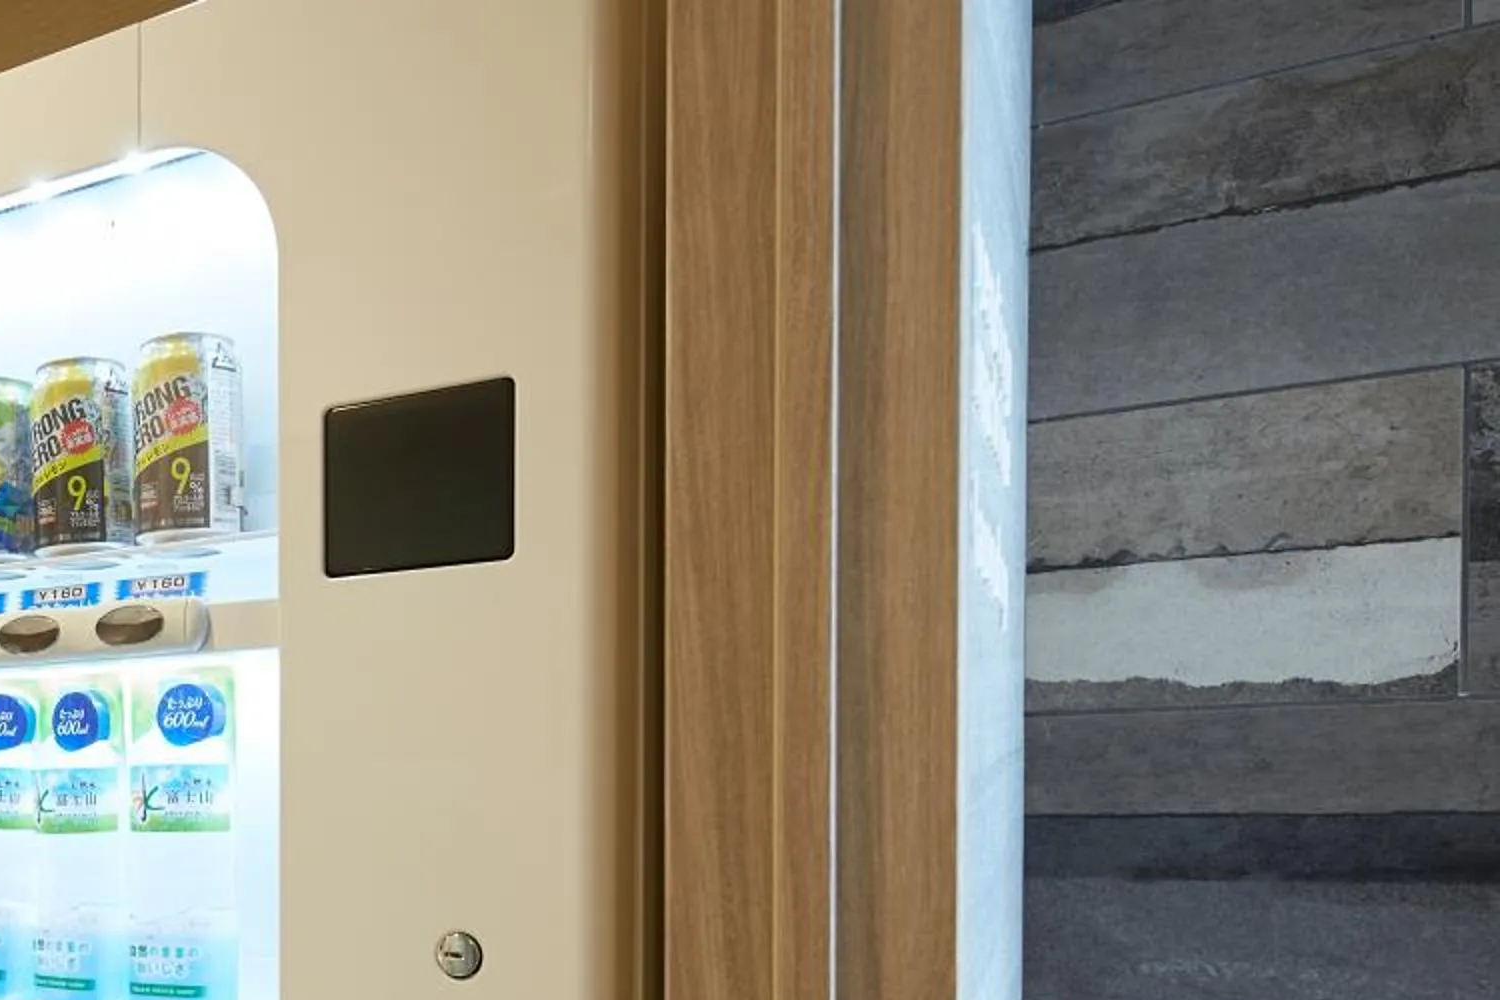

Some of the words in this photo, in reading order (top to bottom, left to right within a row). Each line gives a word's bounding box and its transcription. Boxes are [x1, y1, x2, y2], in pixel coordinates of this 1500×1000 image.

[34, 399, 86, 440] RONG
[134, 376, 191, 427] RONG
[134, 413, 165, 454] ERO
[67, 475, 87, 511] 9
[57, 722, 89, 737] 600ml
[163, 712, 209, 729] 600ml
